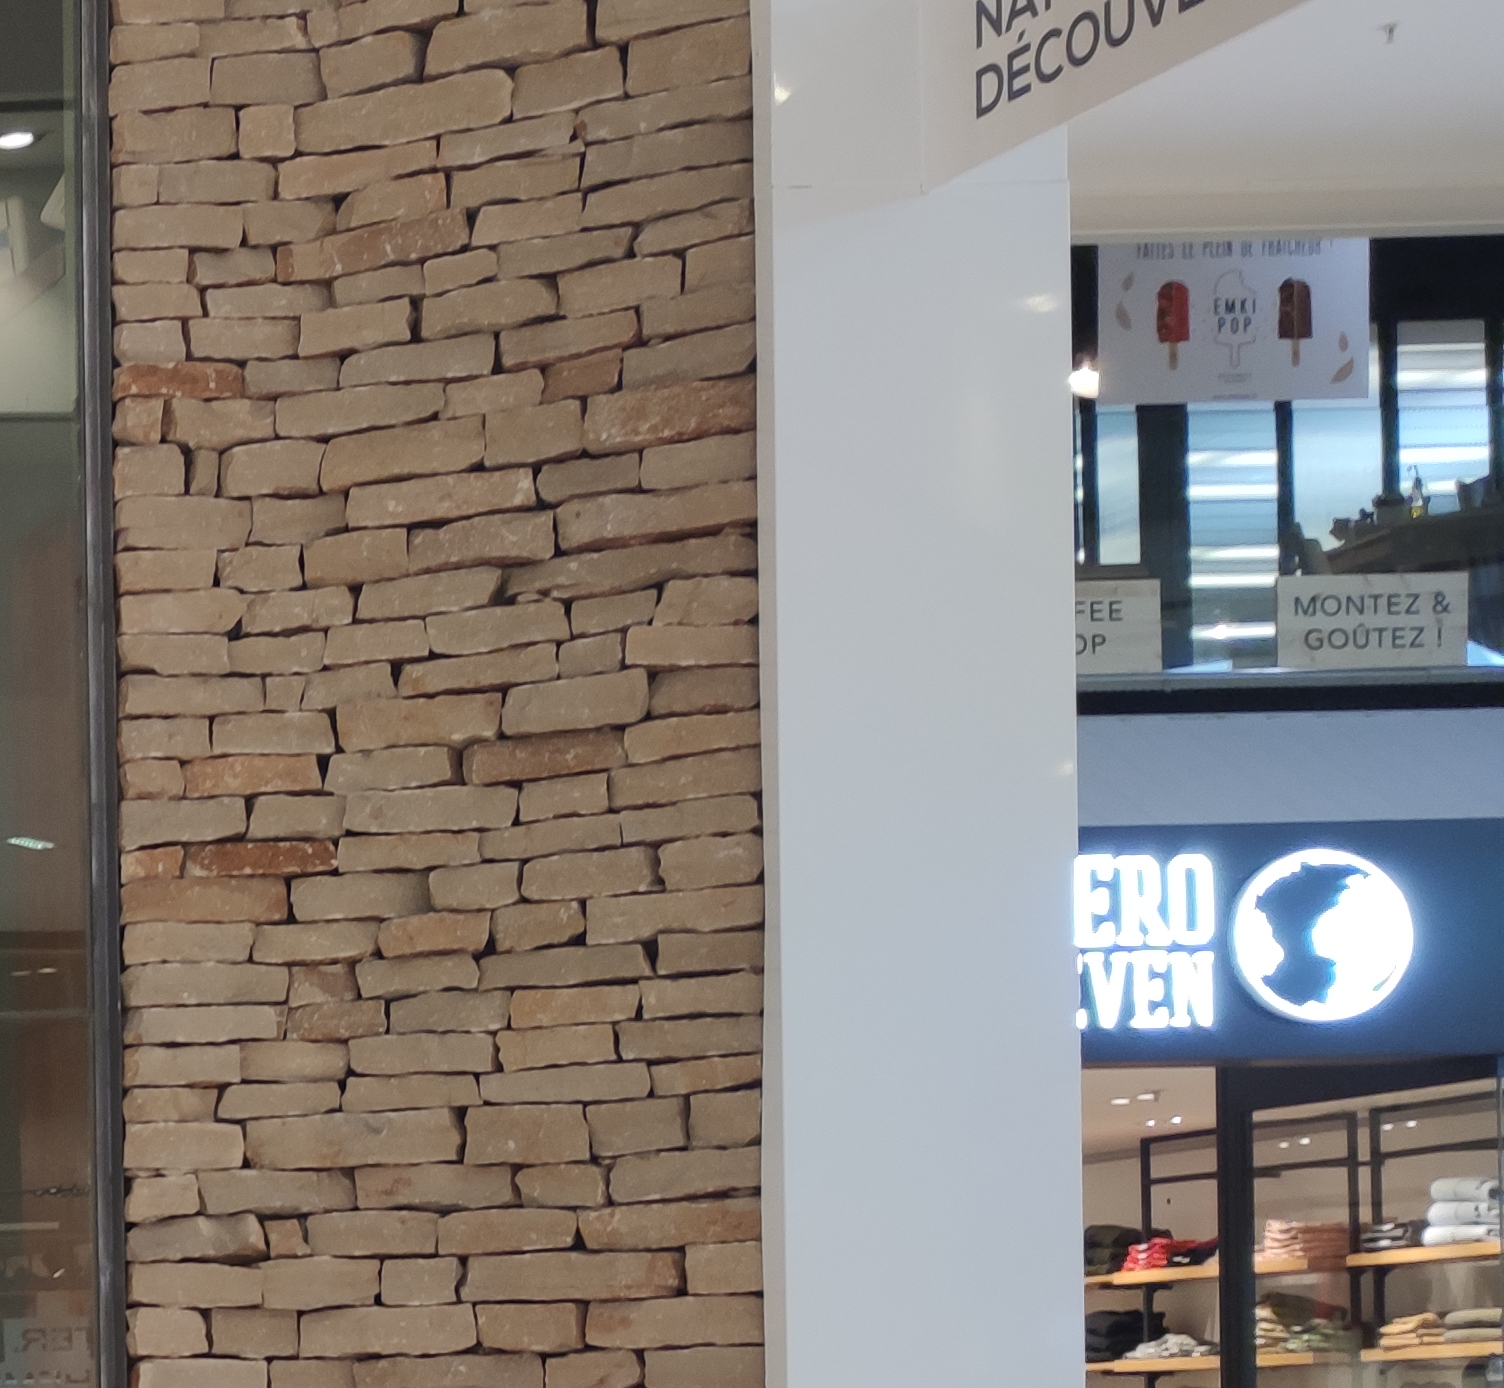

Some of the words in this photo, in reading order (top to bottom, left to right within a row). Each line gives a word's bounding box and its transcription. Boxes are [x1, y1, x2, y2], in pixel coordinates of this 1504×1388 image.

[1214, 297, 1257, 315] EMKI
[1217, 317, 1252, 334] POP
[1293, 592, 1420, 617] MONTEZ
[1433, 591, 1450, 614] &
[1304, 623, 1425, 650] GOÛTEZ
[1438, 624, 1442, 648] !
[1075, 950, 1215, 1030] VEN
